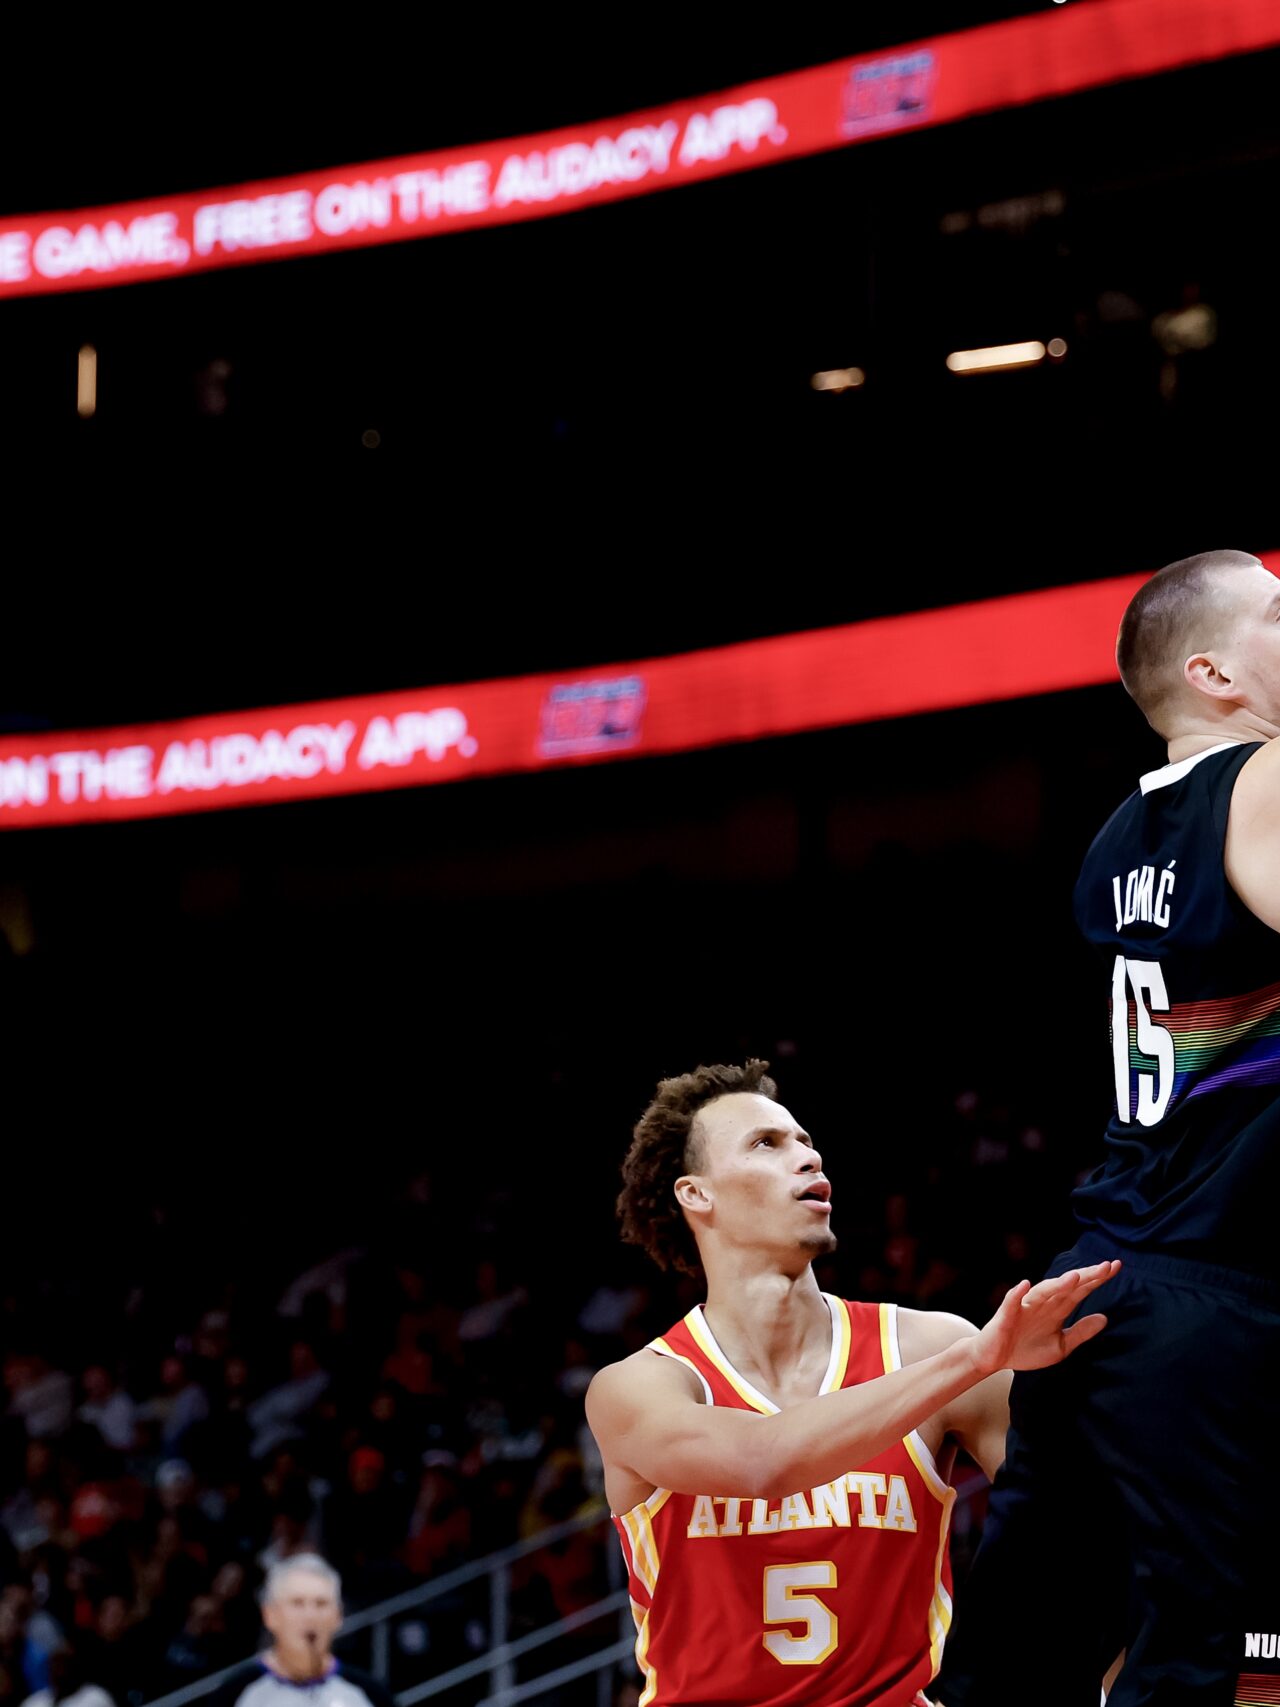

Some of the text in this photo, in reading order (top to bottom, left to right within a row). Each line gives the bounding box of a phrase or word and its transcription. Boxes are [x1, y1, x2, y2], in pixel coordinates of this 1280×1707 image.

[33, 211, 191, 278] GAME,
[193, 189, 314, 256] FREE
[314, 177, 391, 236] ON
[389, 160, 491, 224] THE
[493, 119, 678, 208] AUDACY
[678, 97, 788, 167] APP.
[0, 754, 49, 808] N
[49, 744, 155, 804] THE
[154, 719, 356, 795] AUDACY
[357, 707, 479, 770] APP.
[1112, 954, 1175, 1127] 15
[687, 1471, 918, 1538] ATLANTA
[762, 1560, 838, 1665] 5
